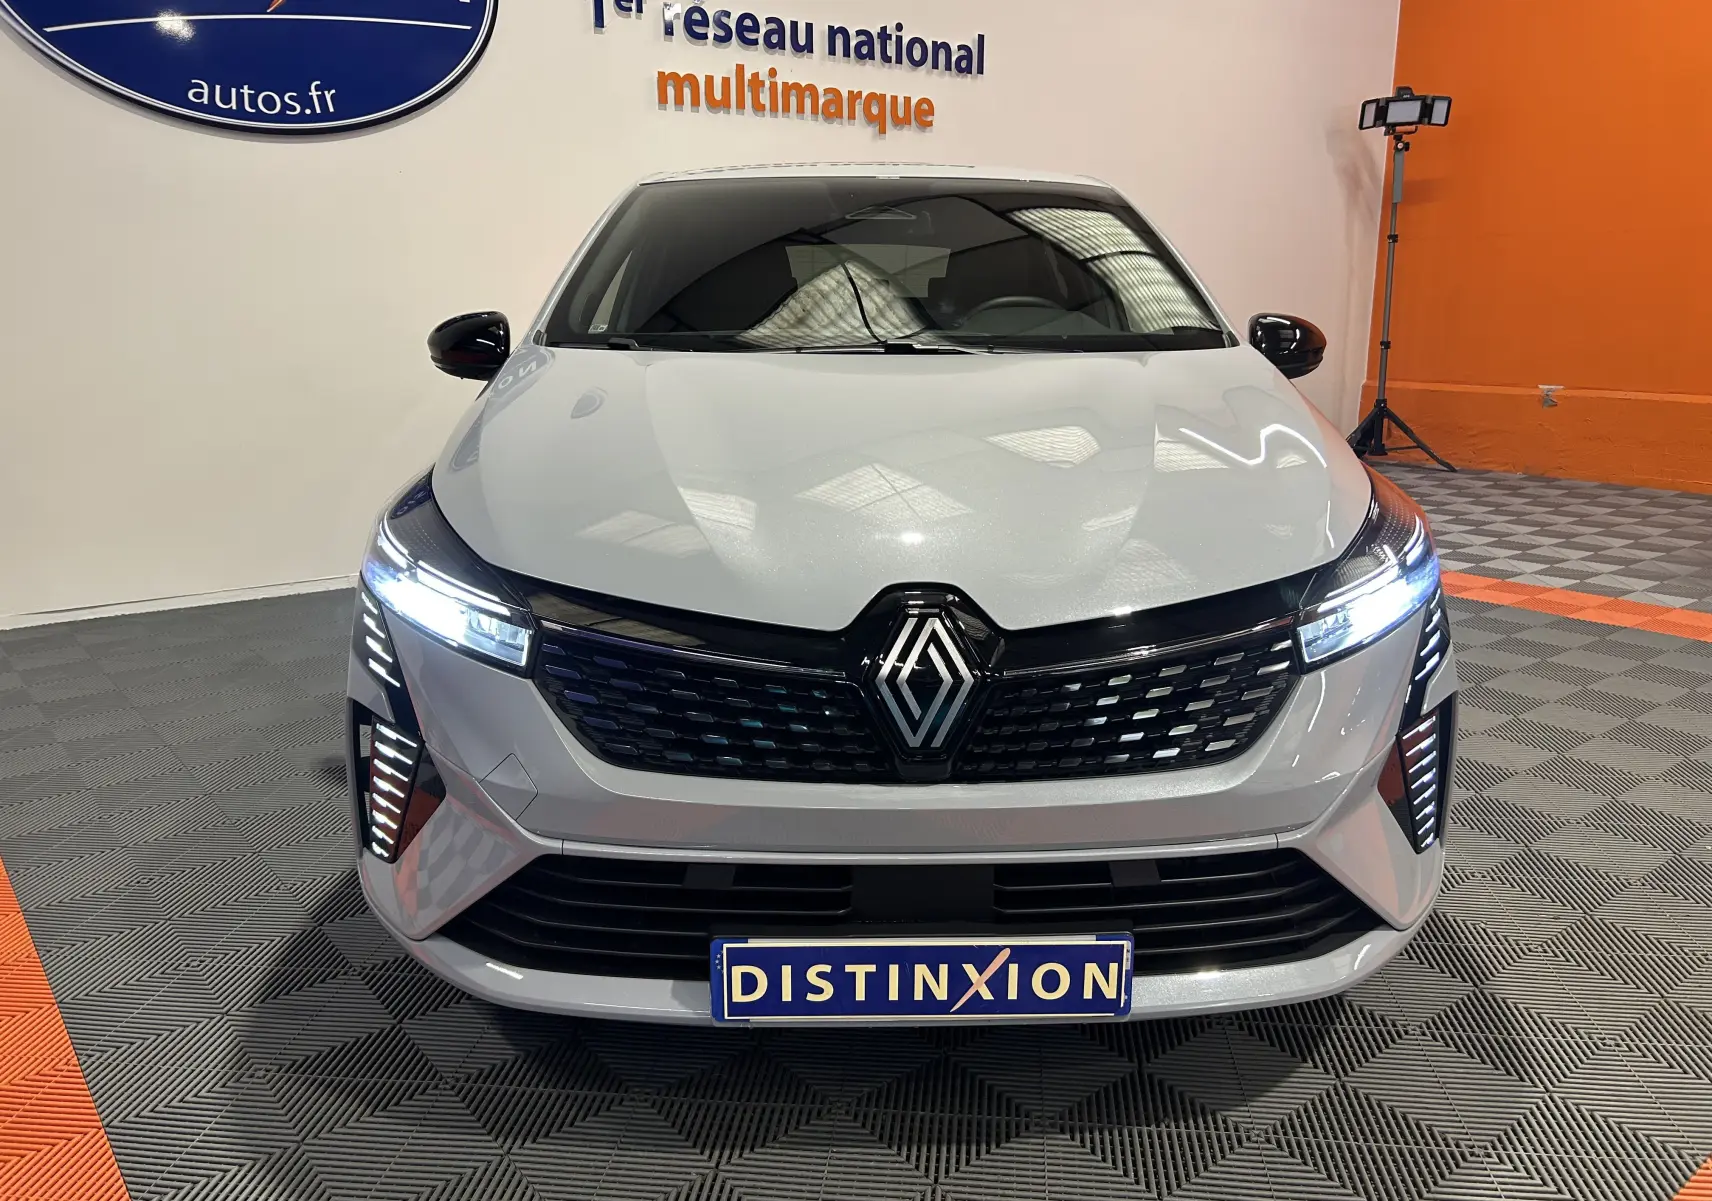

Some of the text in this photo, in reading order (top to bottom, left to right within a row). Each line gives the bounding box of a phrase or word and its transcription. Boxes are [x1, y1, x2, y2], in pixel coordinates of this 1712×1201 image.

[828, 22, 985, 75] national
[188, 79, 336, 114] autos.fr
[657, 64, 935, 135] multimarque
[731, 948, 1118, 1013] DISTINXION
